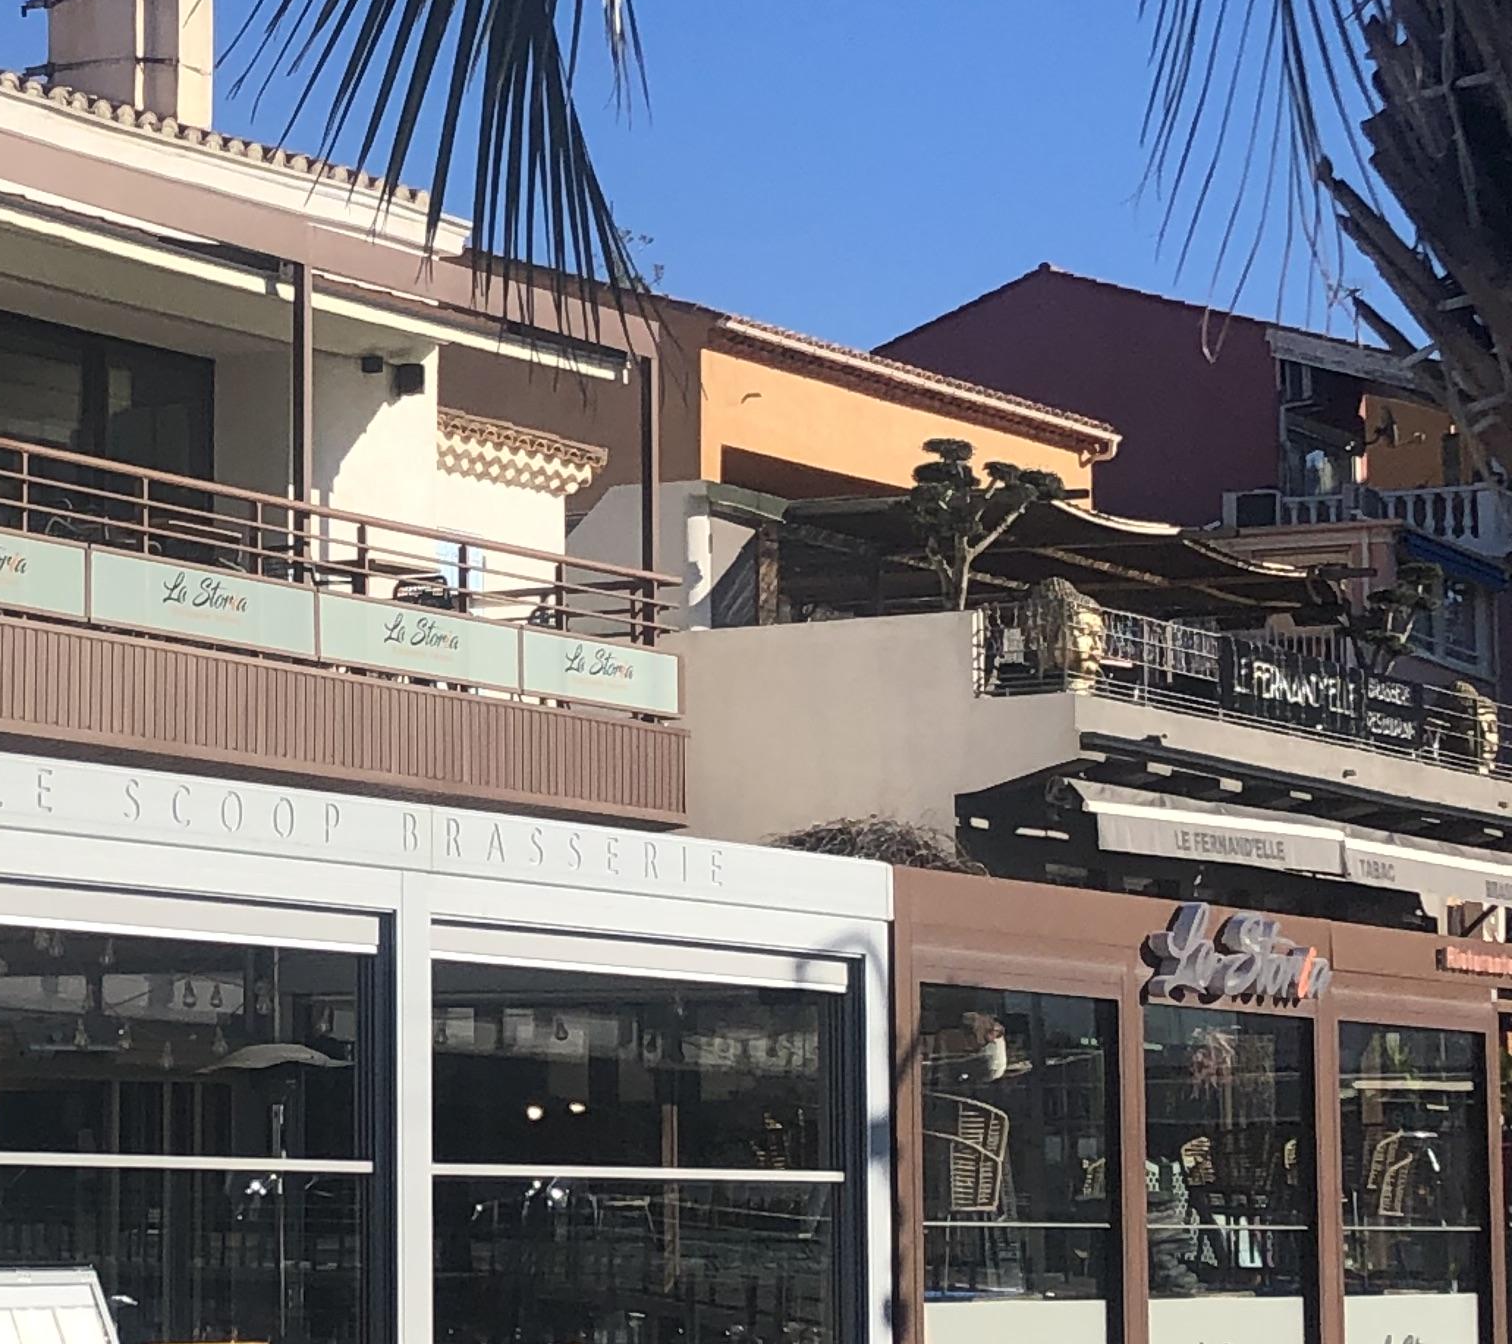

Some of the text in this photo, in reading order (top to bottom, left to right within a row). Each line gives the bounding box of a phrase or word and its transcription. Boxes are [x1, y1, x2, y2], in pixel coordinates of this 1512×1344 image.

[161, 571, 249, 613] La Storia
[383, 612, 460, 650] La Storia
[122, 777, 341, 844] SCOOP
[401, 811, 726, 888] BRASSERIE
[1175, 829, 1192, 852] LE
[1359, 858, 1396, 882] TABAC
